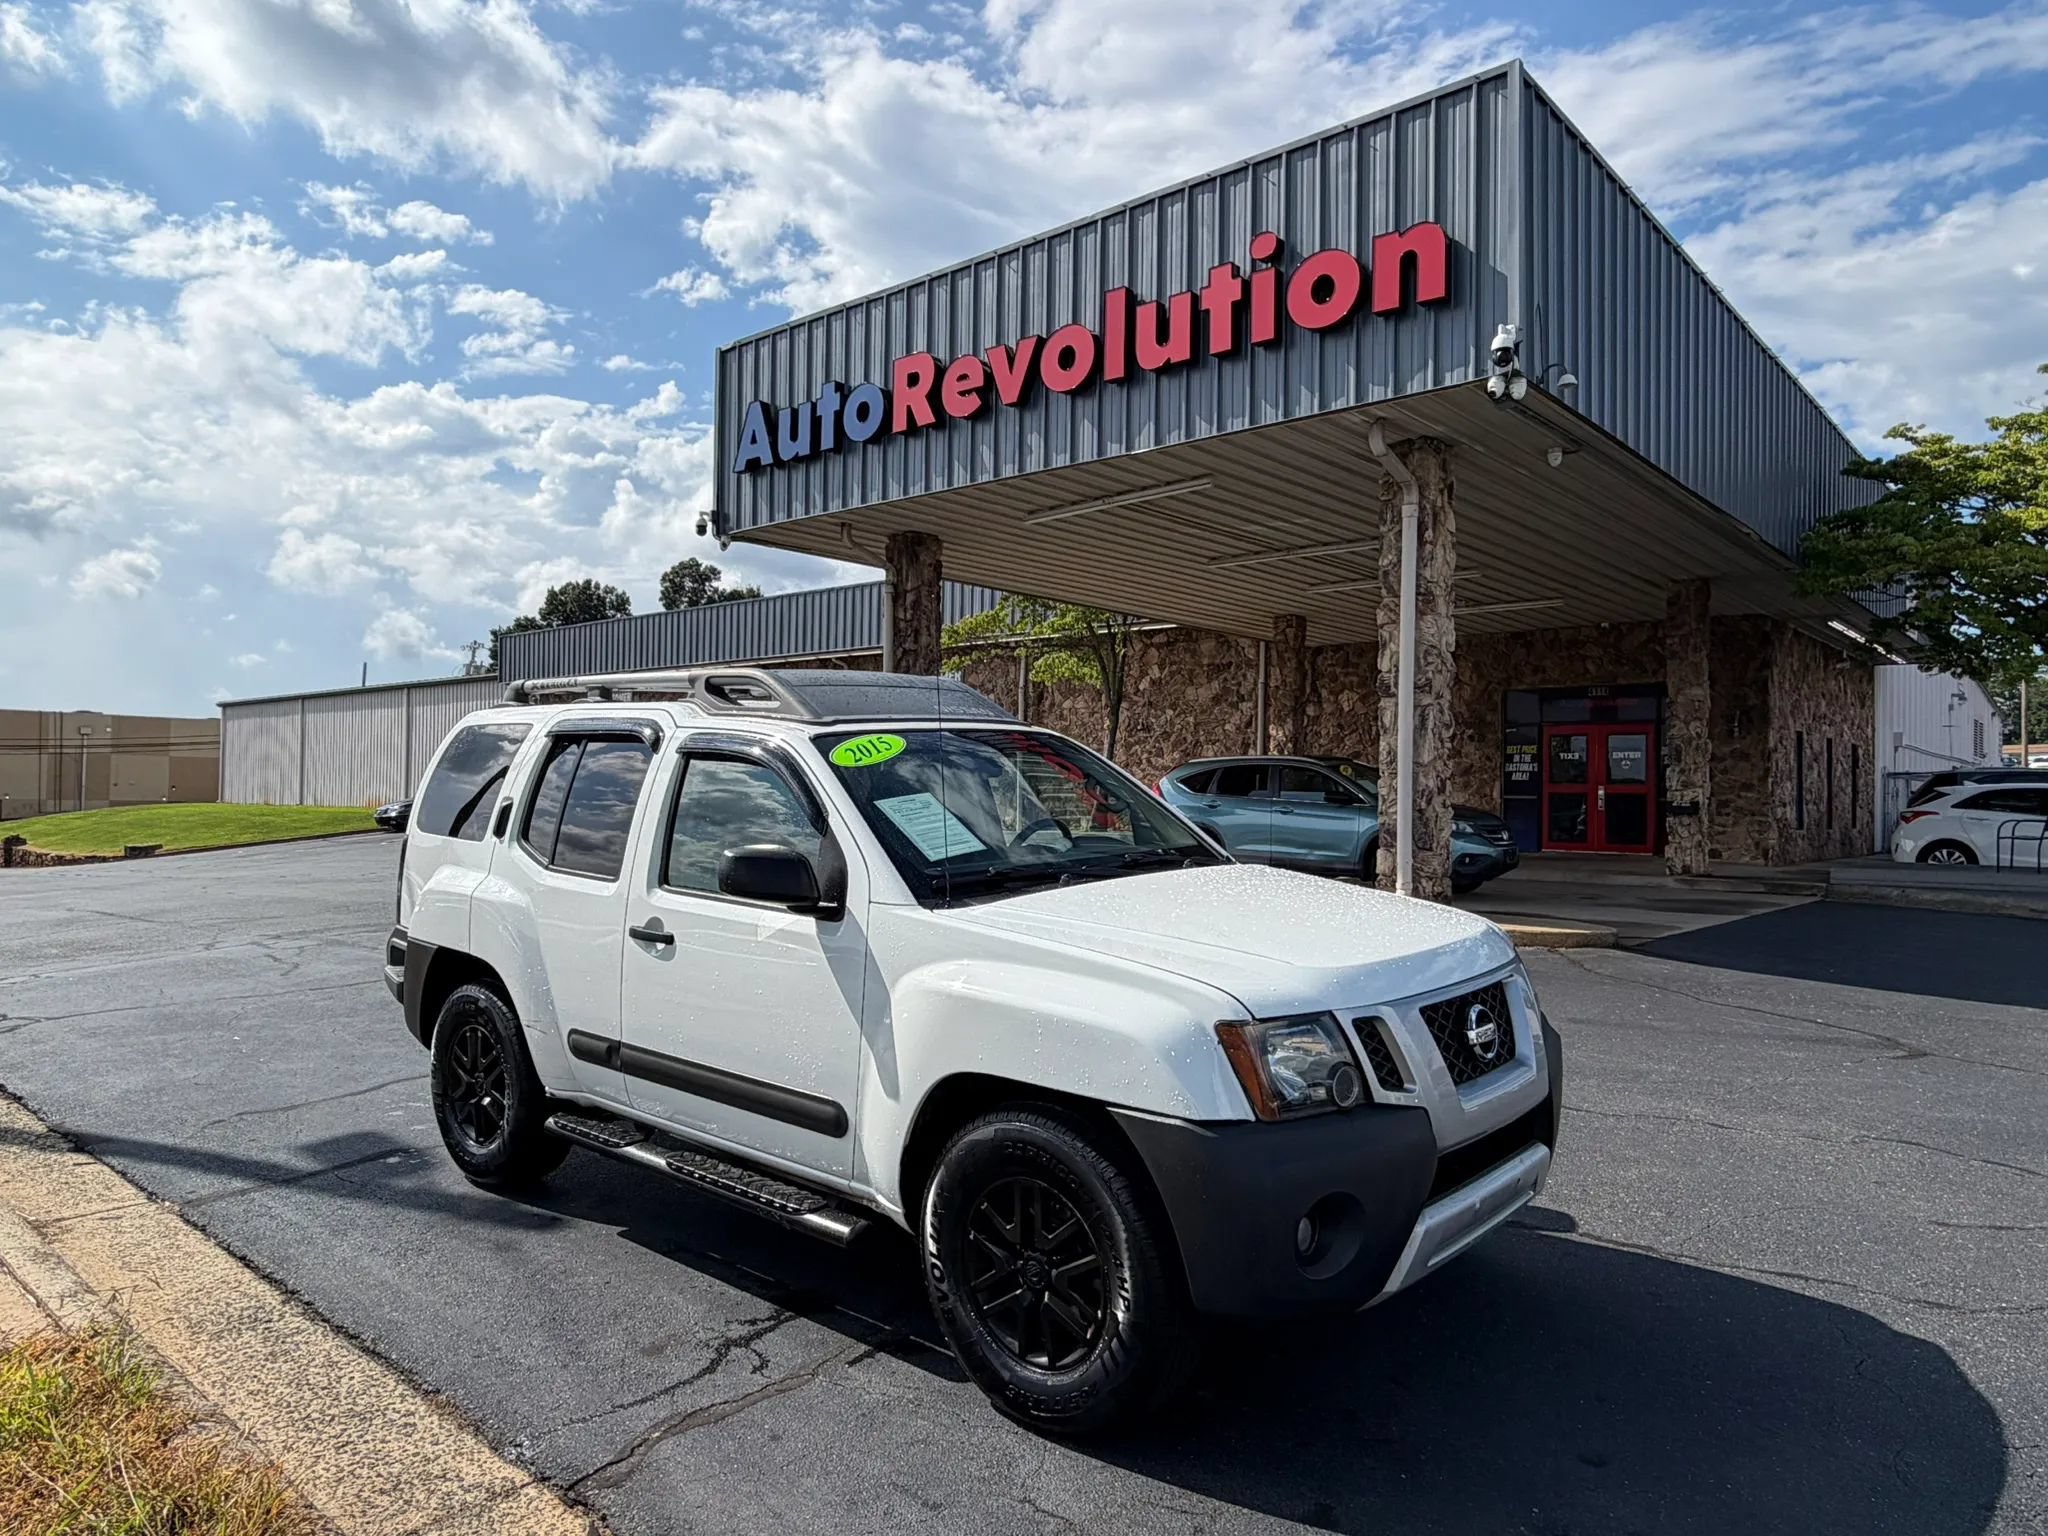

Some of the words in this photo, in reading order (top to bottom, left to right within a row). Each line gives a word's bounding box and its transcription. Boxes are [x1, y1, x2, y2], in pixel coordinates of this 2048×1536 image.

[844, 736, 893, 763] 2015
[1506, 745, 1521, 754] BEST
[1522, 745, 1537, 754] PRICE
[1521, 754, 1532, 762] THE
[1612, 751, 1641, 759] ENTER
